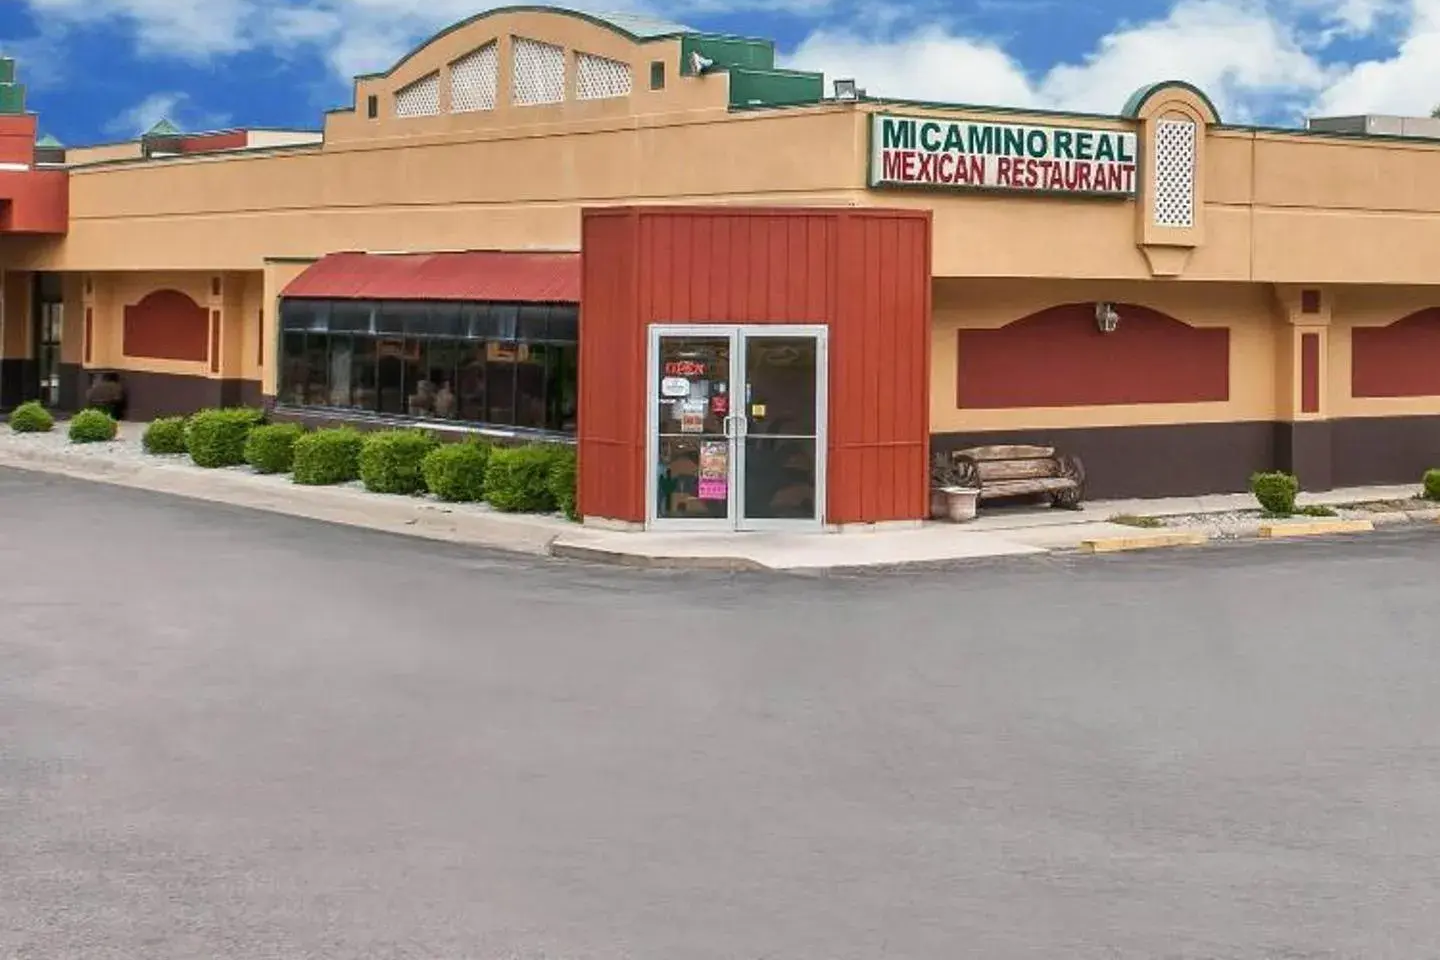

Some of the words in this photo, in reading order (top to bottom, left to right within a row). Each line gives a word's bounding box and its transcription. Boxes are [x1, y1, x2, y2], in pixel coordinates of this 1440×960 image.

[1053, 131, 1134, 161] REAL
[882, 151, 986, 185] MEXICAN
[998, 157, 1136, 190] RESTAURANT
